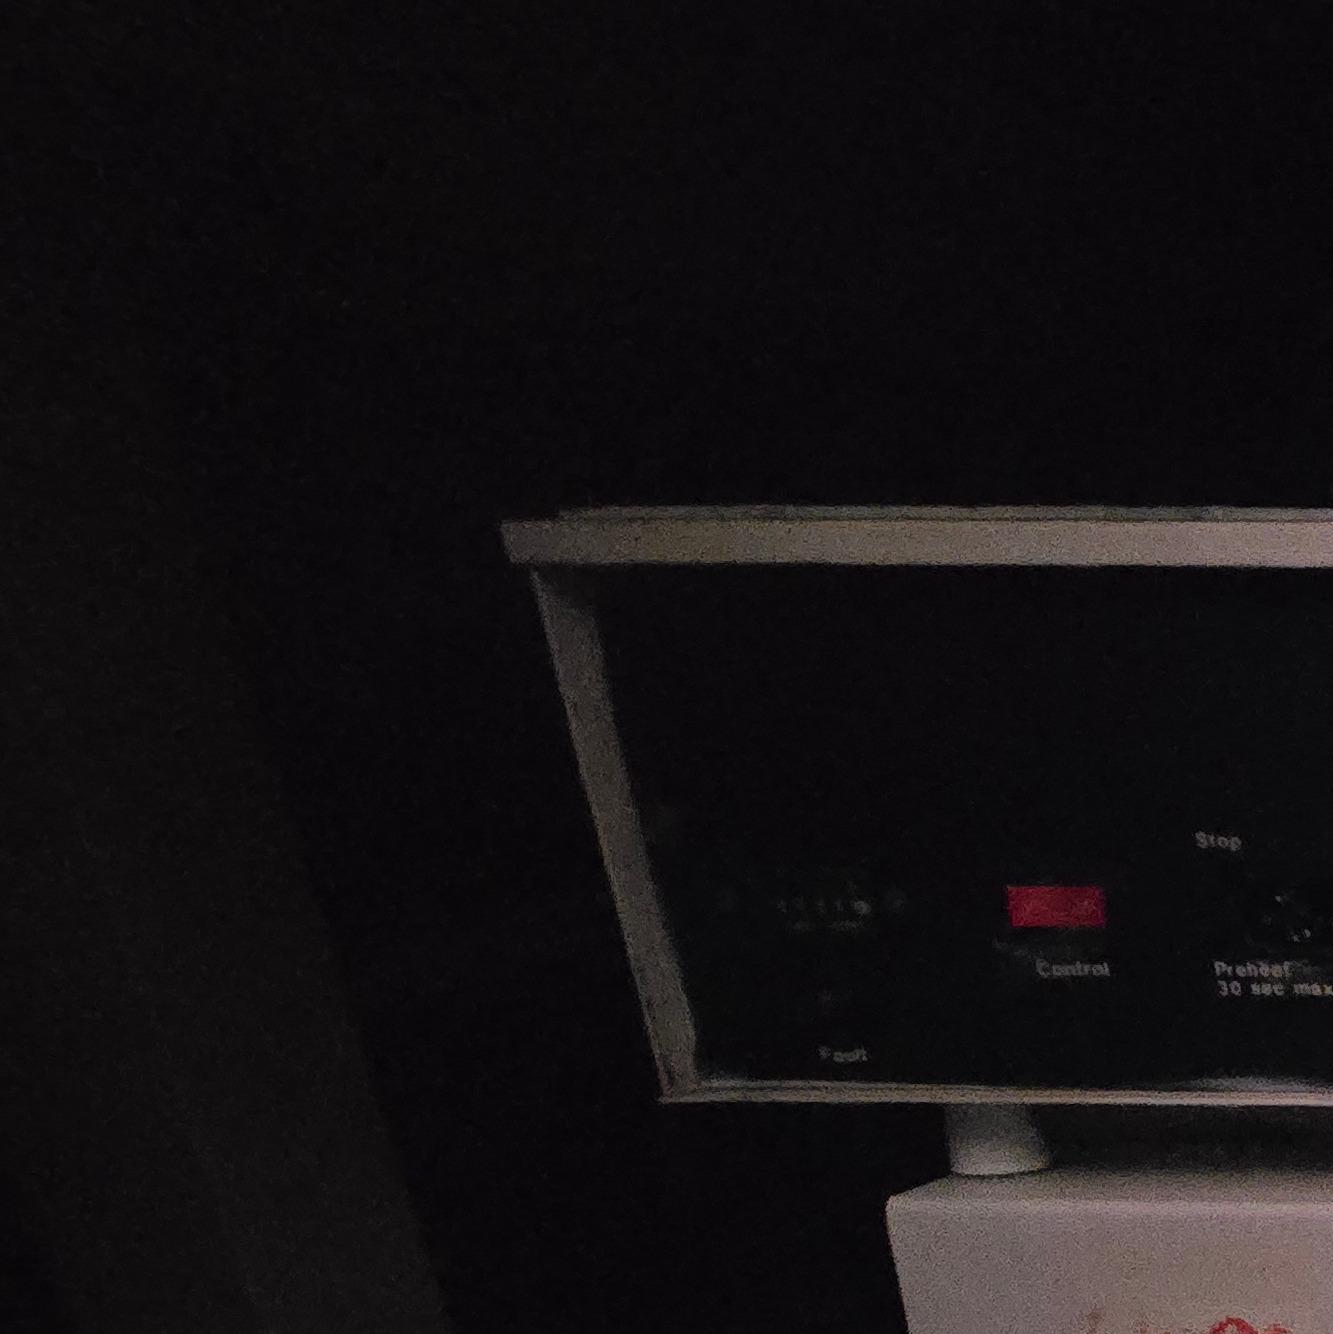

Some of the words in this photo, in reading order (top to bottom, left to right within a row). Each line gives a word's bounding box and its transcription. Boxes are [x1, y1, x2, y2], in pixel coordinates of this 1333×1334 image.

[1195, 831, 1243, 852] Stop
[1035, 959, 1110, 978] Control
[1217, 982, 1243, 997] 30
[1252, 983, 1285, 997] sec
